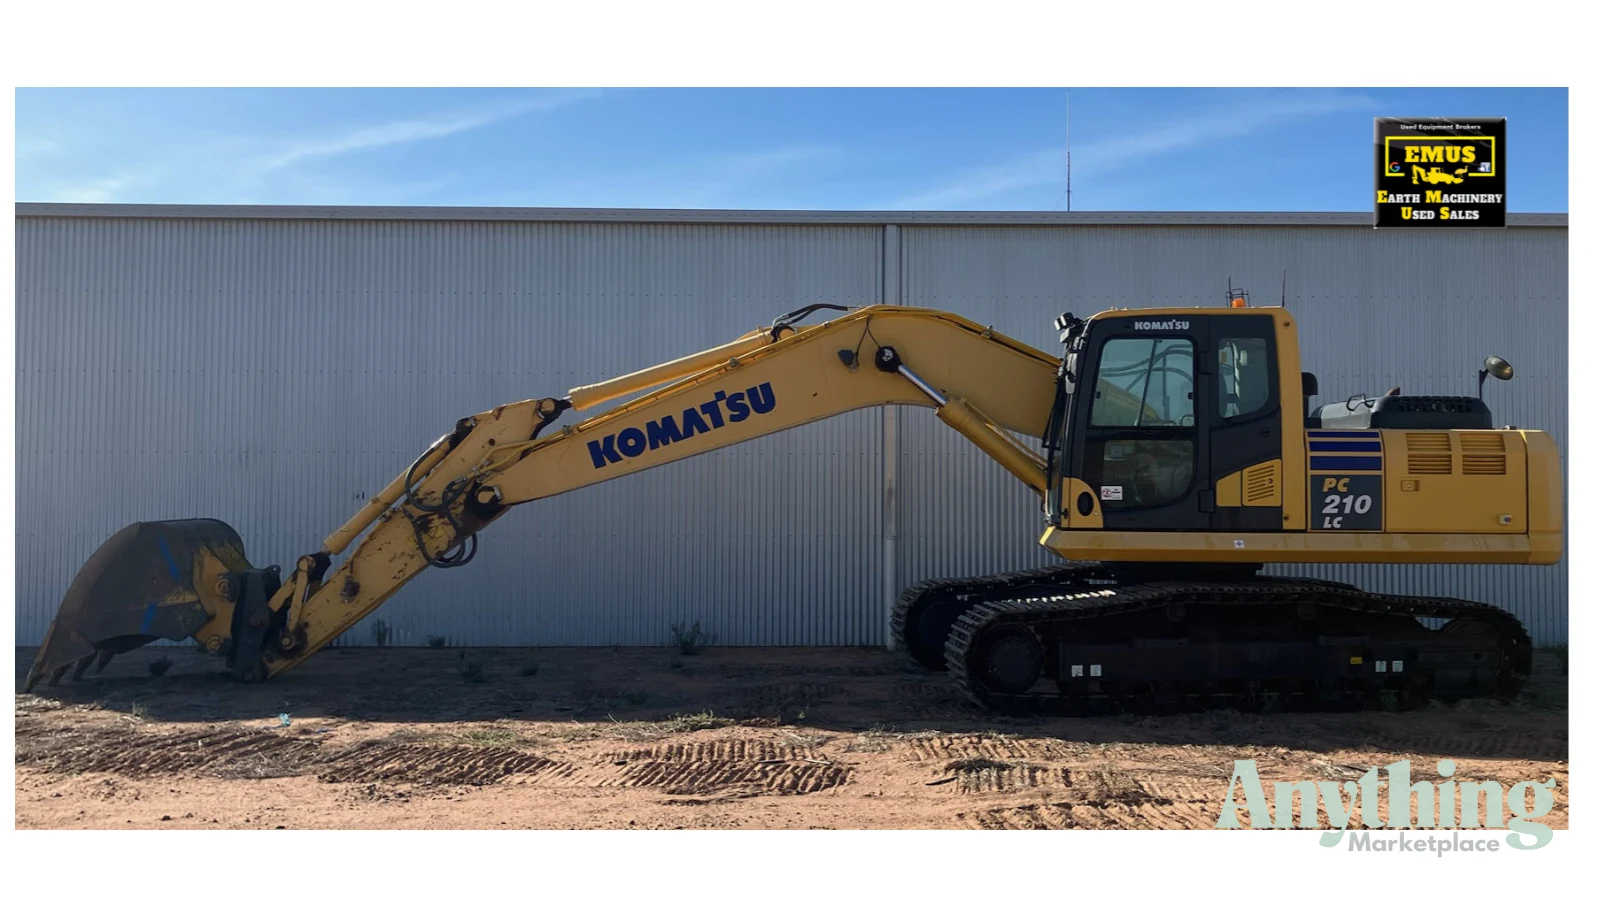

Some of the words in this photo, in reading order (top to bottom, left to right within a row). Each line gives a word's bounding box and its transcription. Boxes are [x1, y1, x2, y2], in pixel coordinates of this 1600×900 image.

[1134, 319, 1190, 330] KOMATSU
[587, 382, 776, 469] KOMATSU
[1322, 477, 1350, 493] PC
[1321, 494, 1372, 515] 210
[1323, 516, 1343, 529] LC
